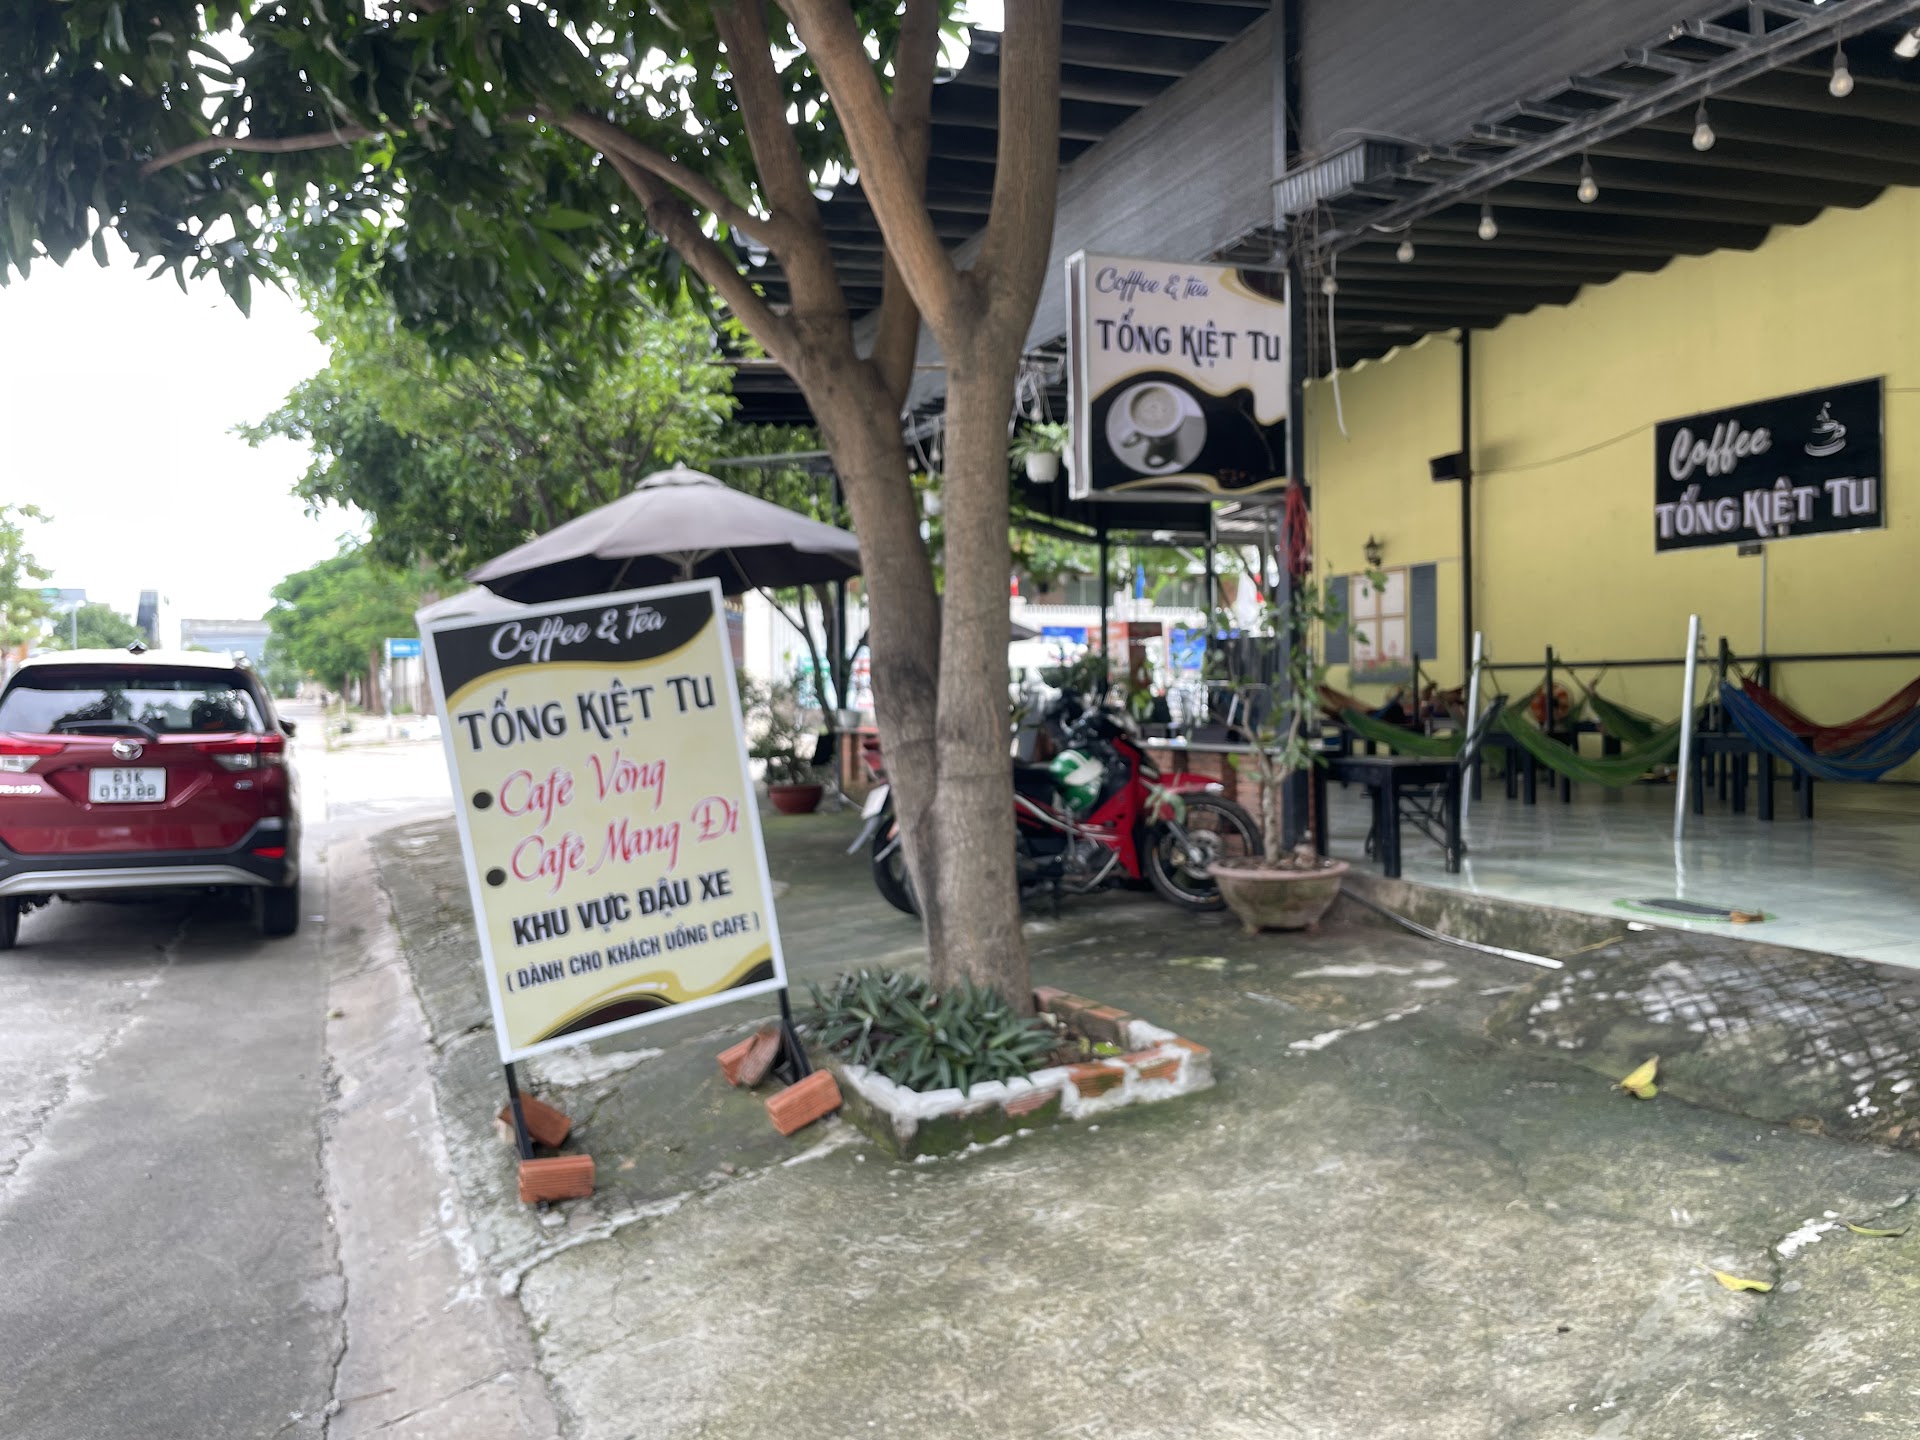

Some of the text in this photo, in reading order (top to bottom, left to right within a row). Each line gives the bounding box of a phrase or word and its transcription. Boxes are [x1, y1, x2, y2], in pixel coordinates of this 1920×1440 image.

[1095, 267, 1159, 301] Coffee
[1163, 273, 1178, 300] &
[1095, 308, 1281, 368] TỐNG KIỆT TU
[1668, 419, 1773, 481] Coffee
[1655, 475, 1877, 539] TỐNG KIỆT TU
[490, 616, 591, 663] Coffee
[596, 608, 620, 644] &
[457, 675, 716, 750] TỐNG KIỆT TU
[587, 817, 681, 874] Mang
[512, 869, 733, 946] KHU VỰC ĐẬU XE
[569, 950, 603, 975] CHO
[606, 936, 661, 966] KHÁCH
[664, 922, 708, 950] UỐNG
